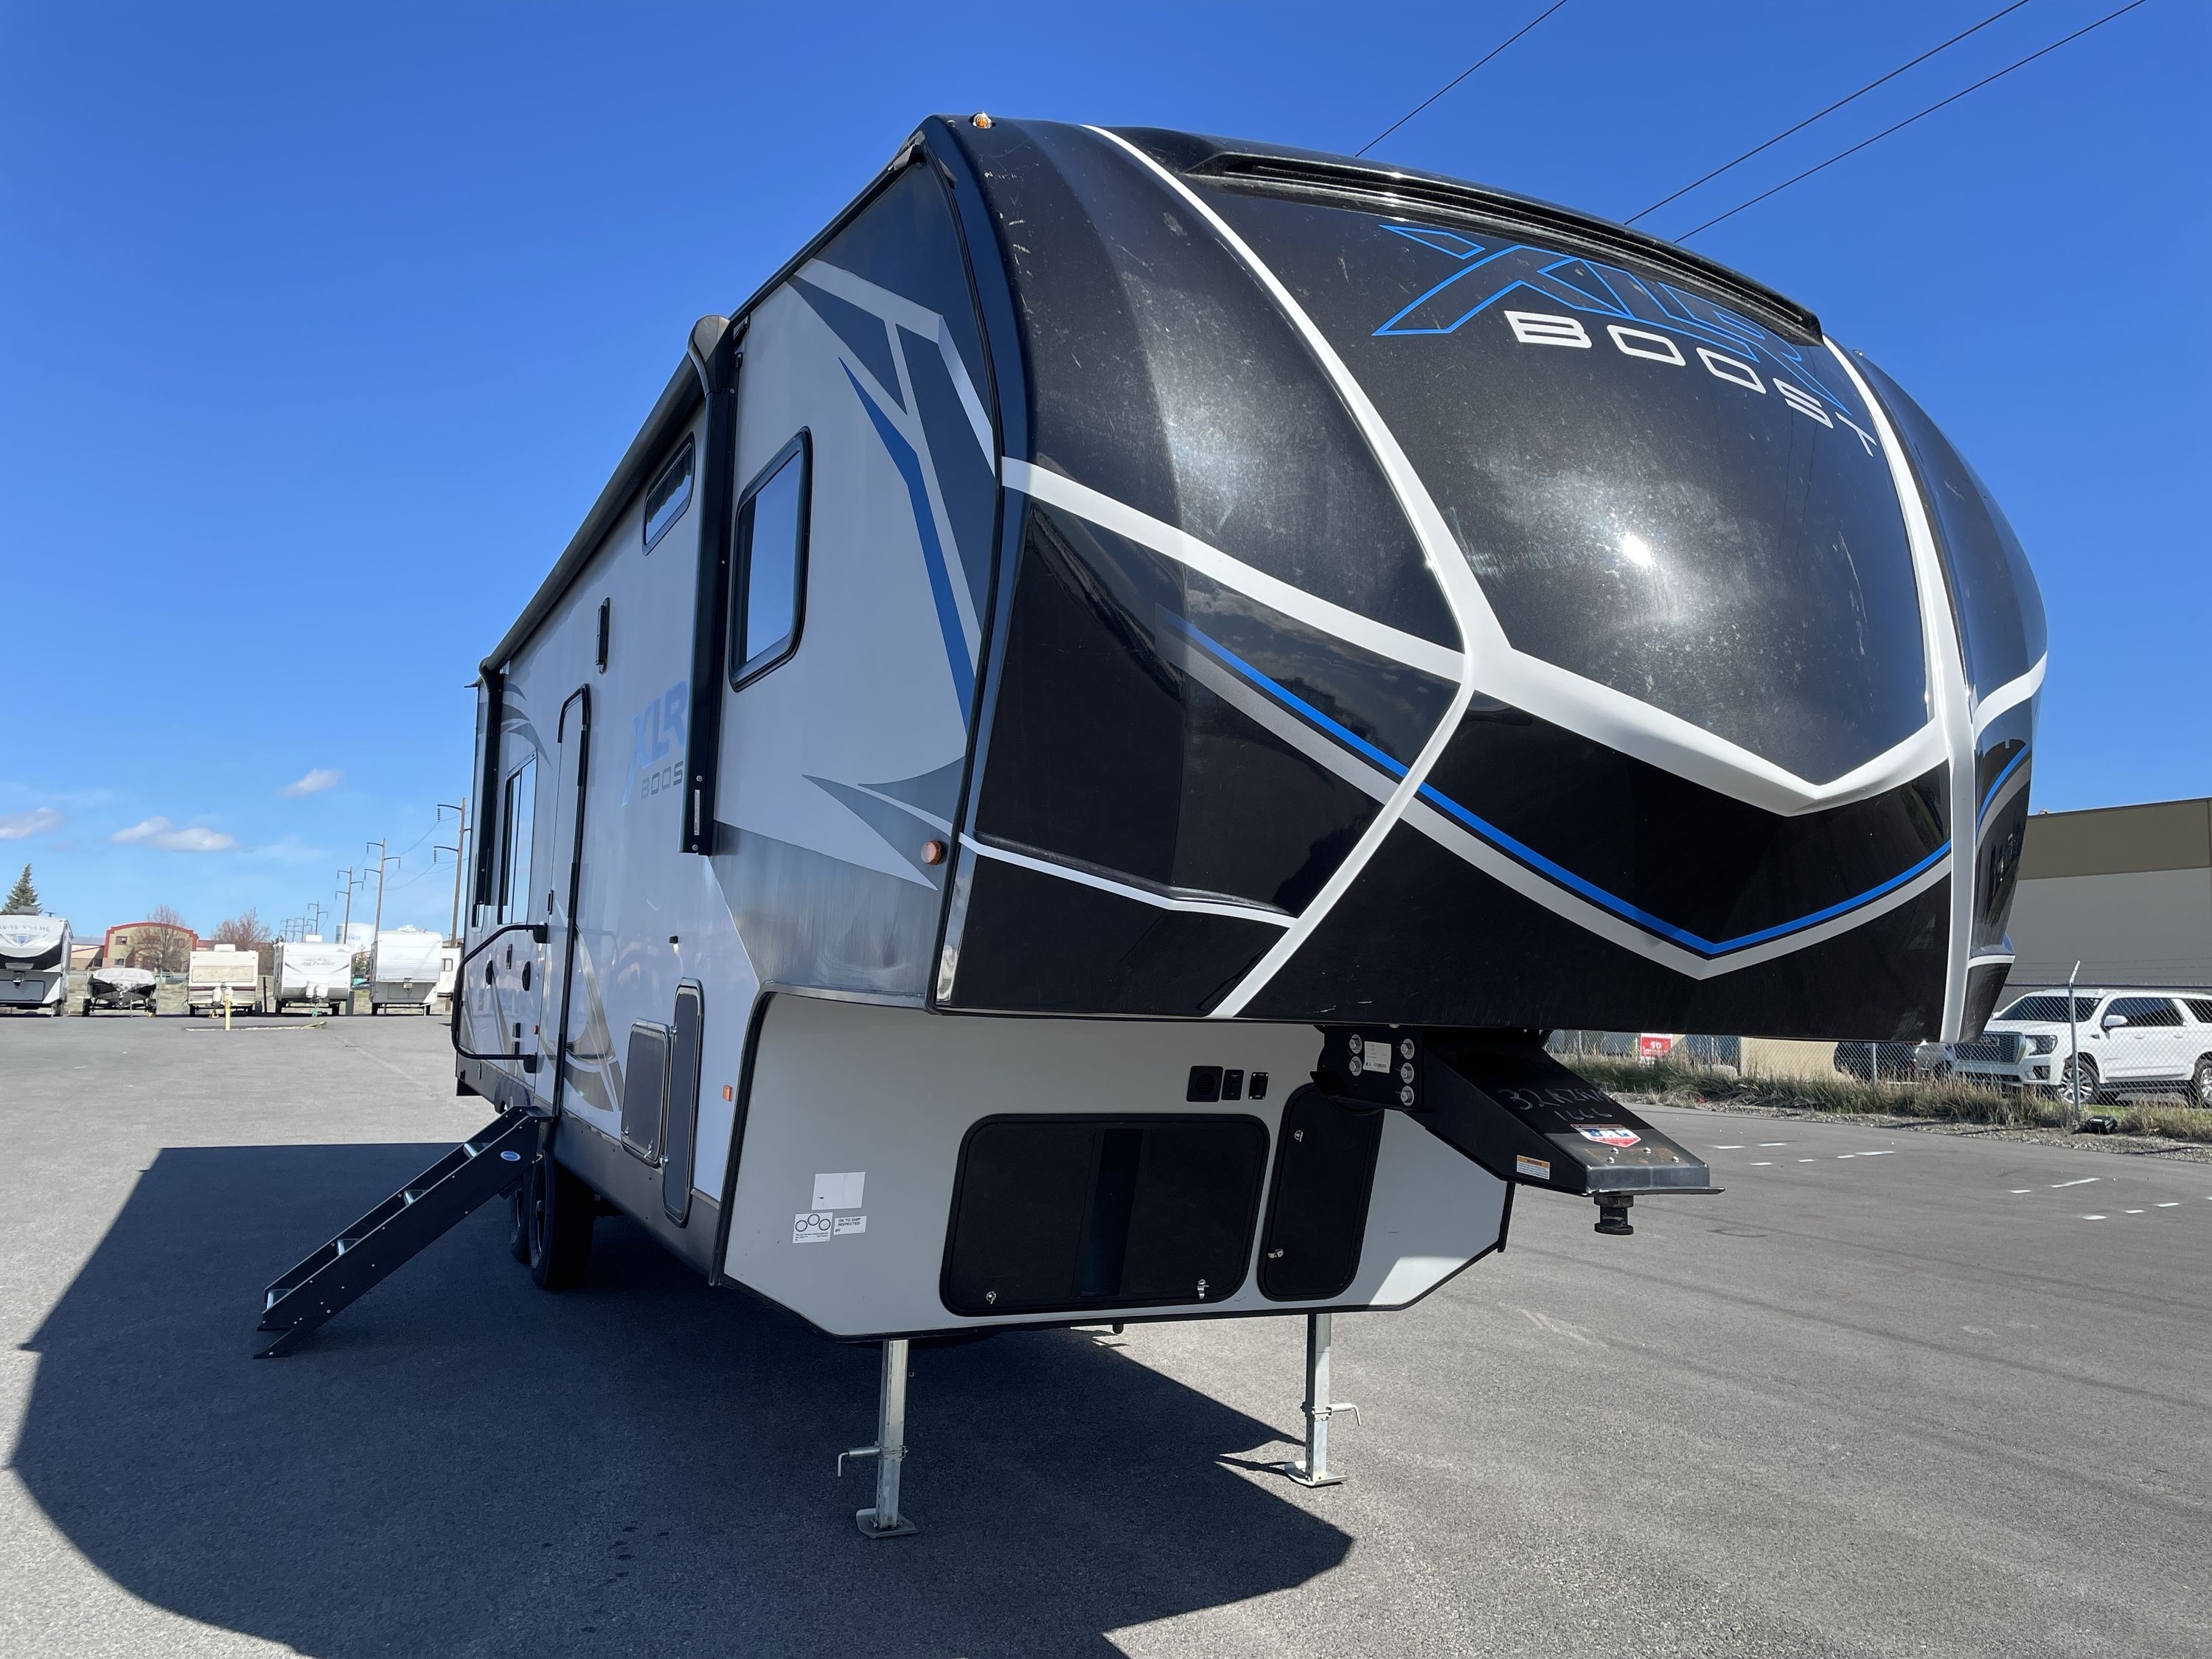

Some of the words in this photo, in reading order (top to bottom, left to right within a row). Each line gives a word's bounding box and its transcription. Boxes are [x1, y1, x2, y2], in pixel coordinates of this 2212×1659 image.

[1372, 224, 1851, 415] XLR
[1503, 310, 1877, 456] BOOST
[621, 680, 689, 807] XLR
[641, 760, 684, 801] BOOS
